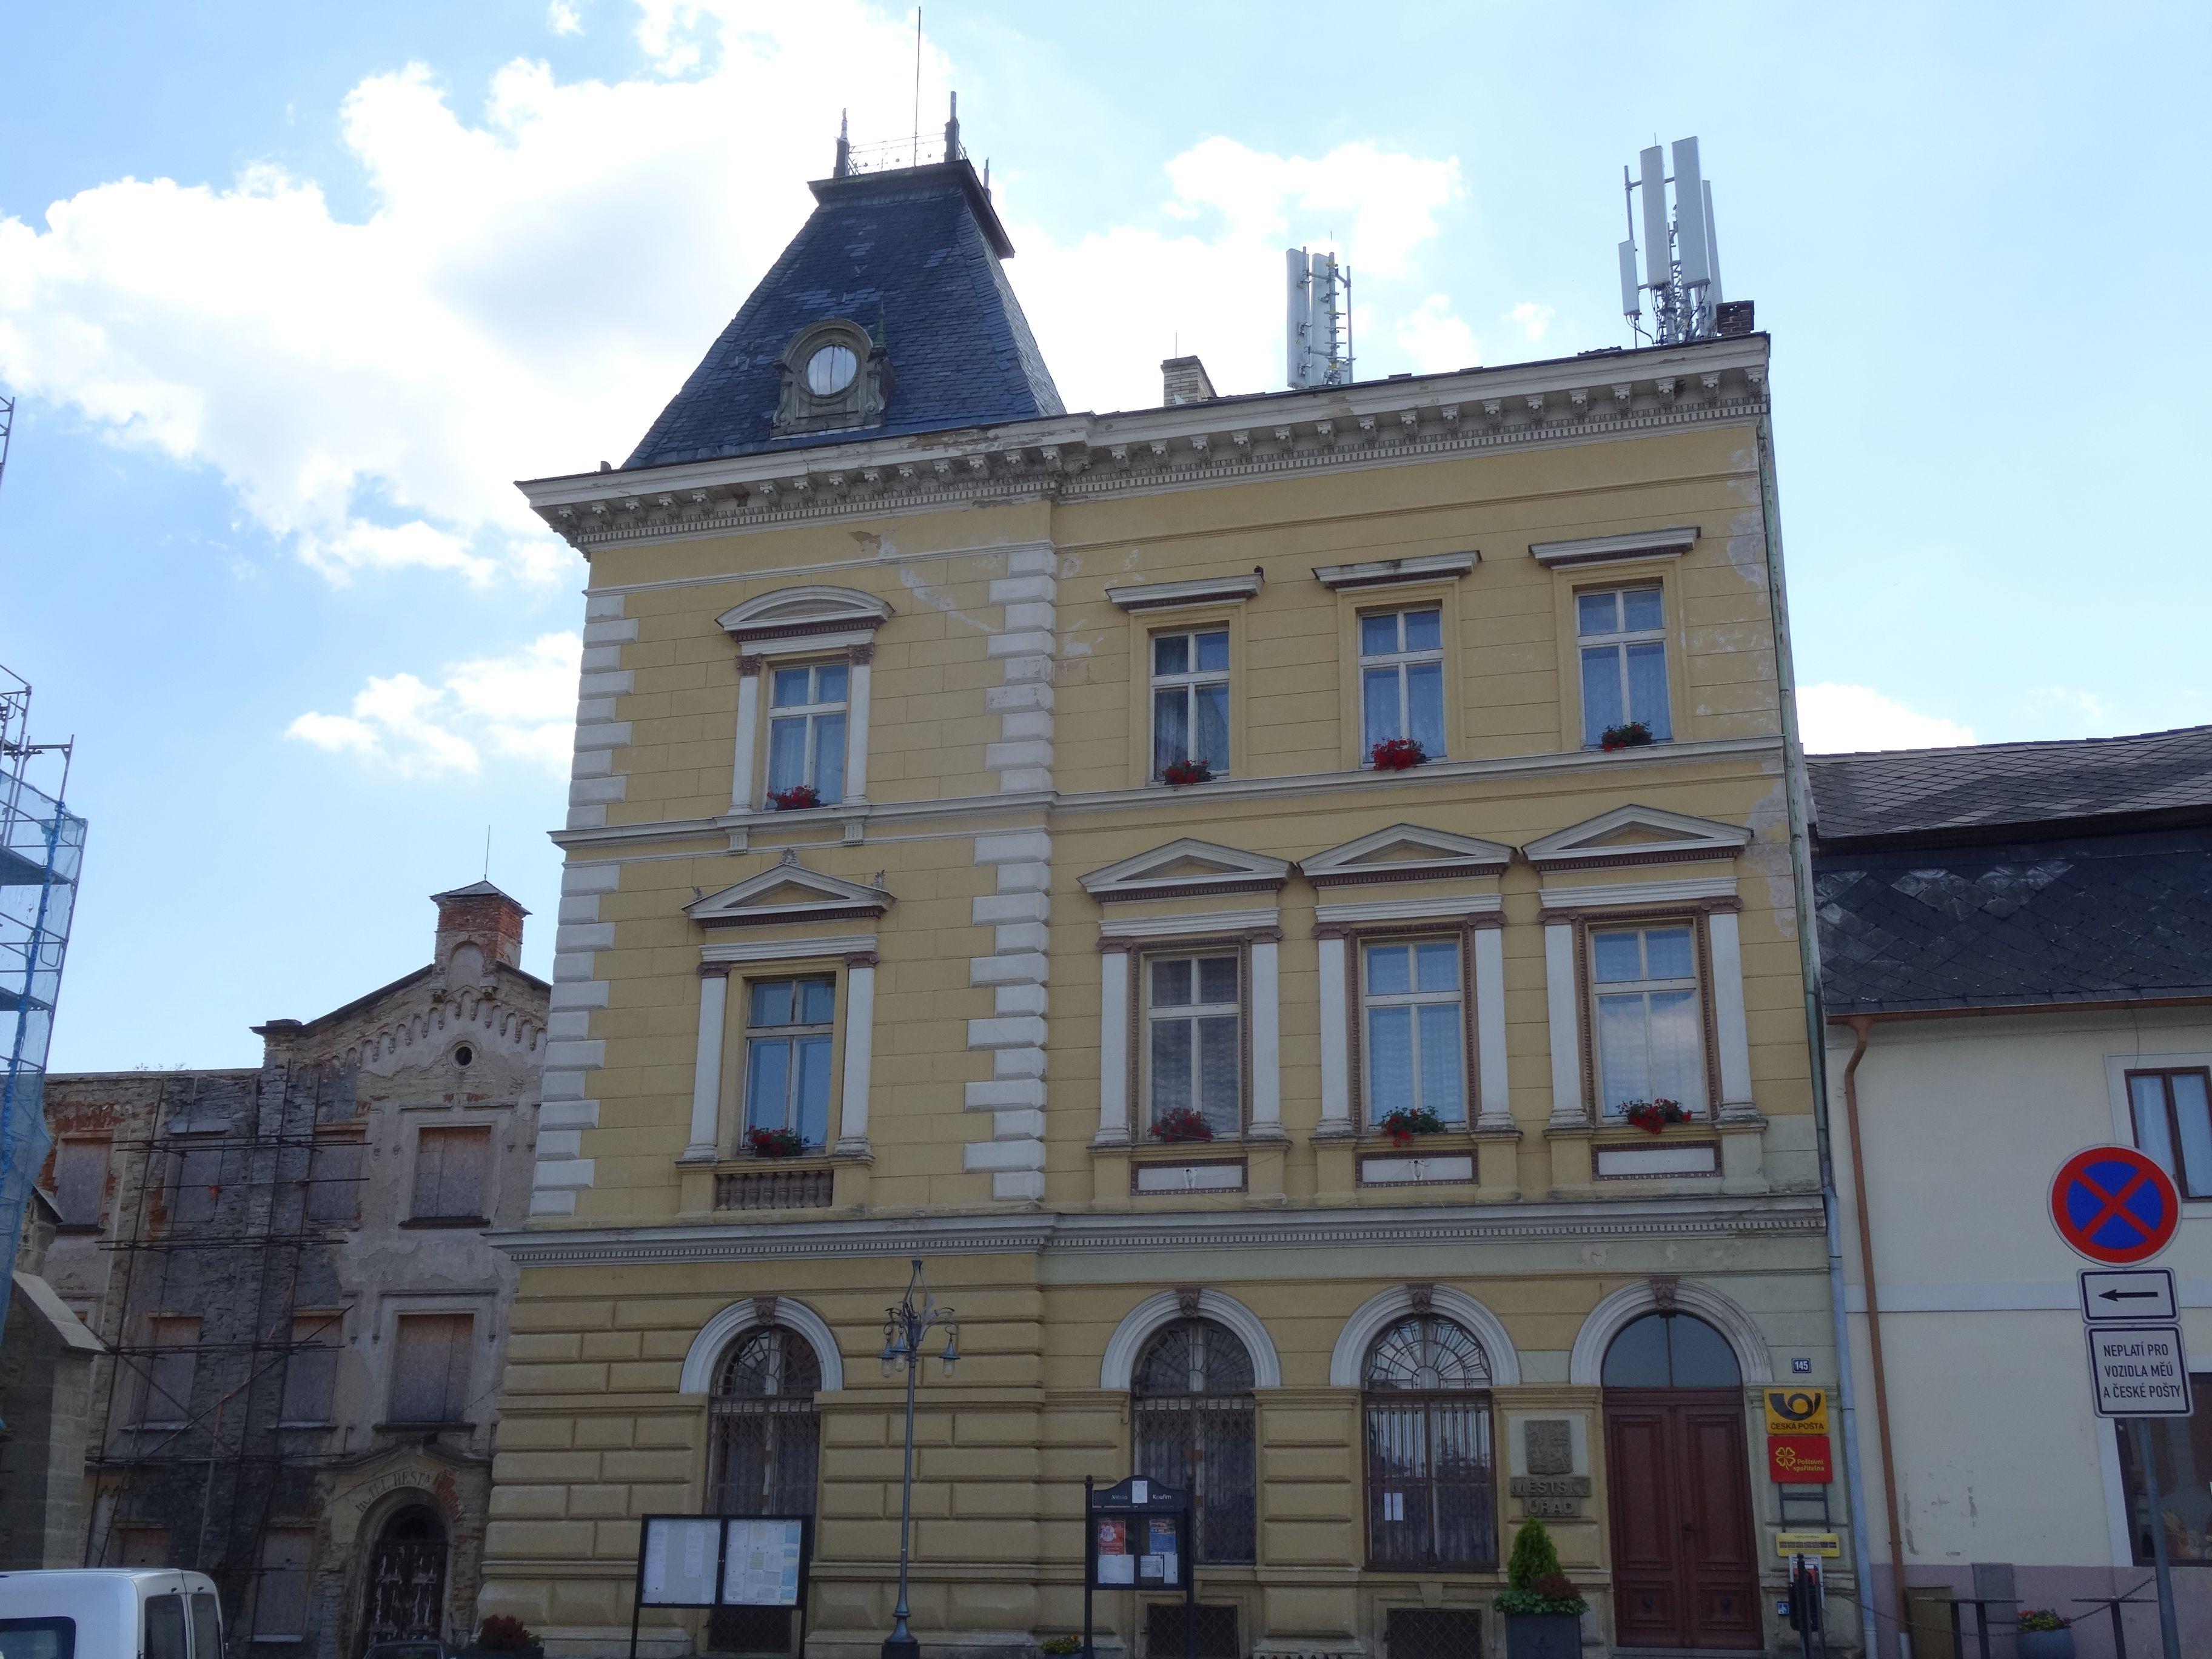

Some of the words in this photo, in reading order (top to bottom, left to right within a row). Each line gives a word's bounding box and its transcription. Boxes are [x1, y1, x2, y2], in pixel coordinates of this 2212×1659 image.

[2103, 1341, 2145, 1357] NEPLATÍ
[2147, 1343, 2169, 1356] PRO
[1794, 1361, 1808, 1371] 145
[2104, 1364, 2148, 1378] VOZIDLA
[2151, 1361, 2173, 1377] MĚÚ
[2103, 1386, 2111, 1398] A
[2113, 1382, 2147, 1398] ČESKÉ
[2149, 1382, 2181, 1398] POŠTY
[1770, 1421, 1797, 1430] ČESKÁ
[1798, 1421, 1825, 1430] POŠTA
